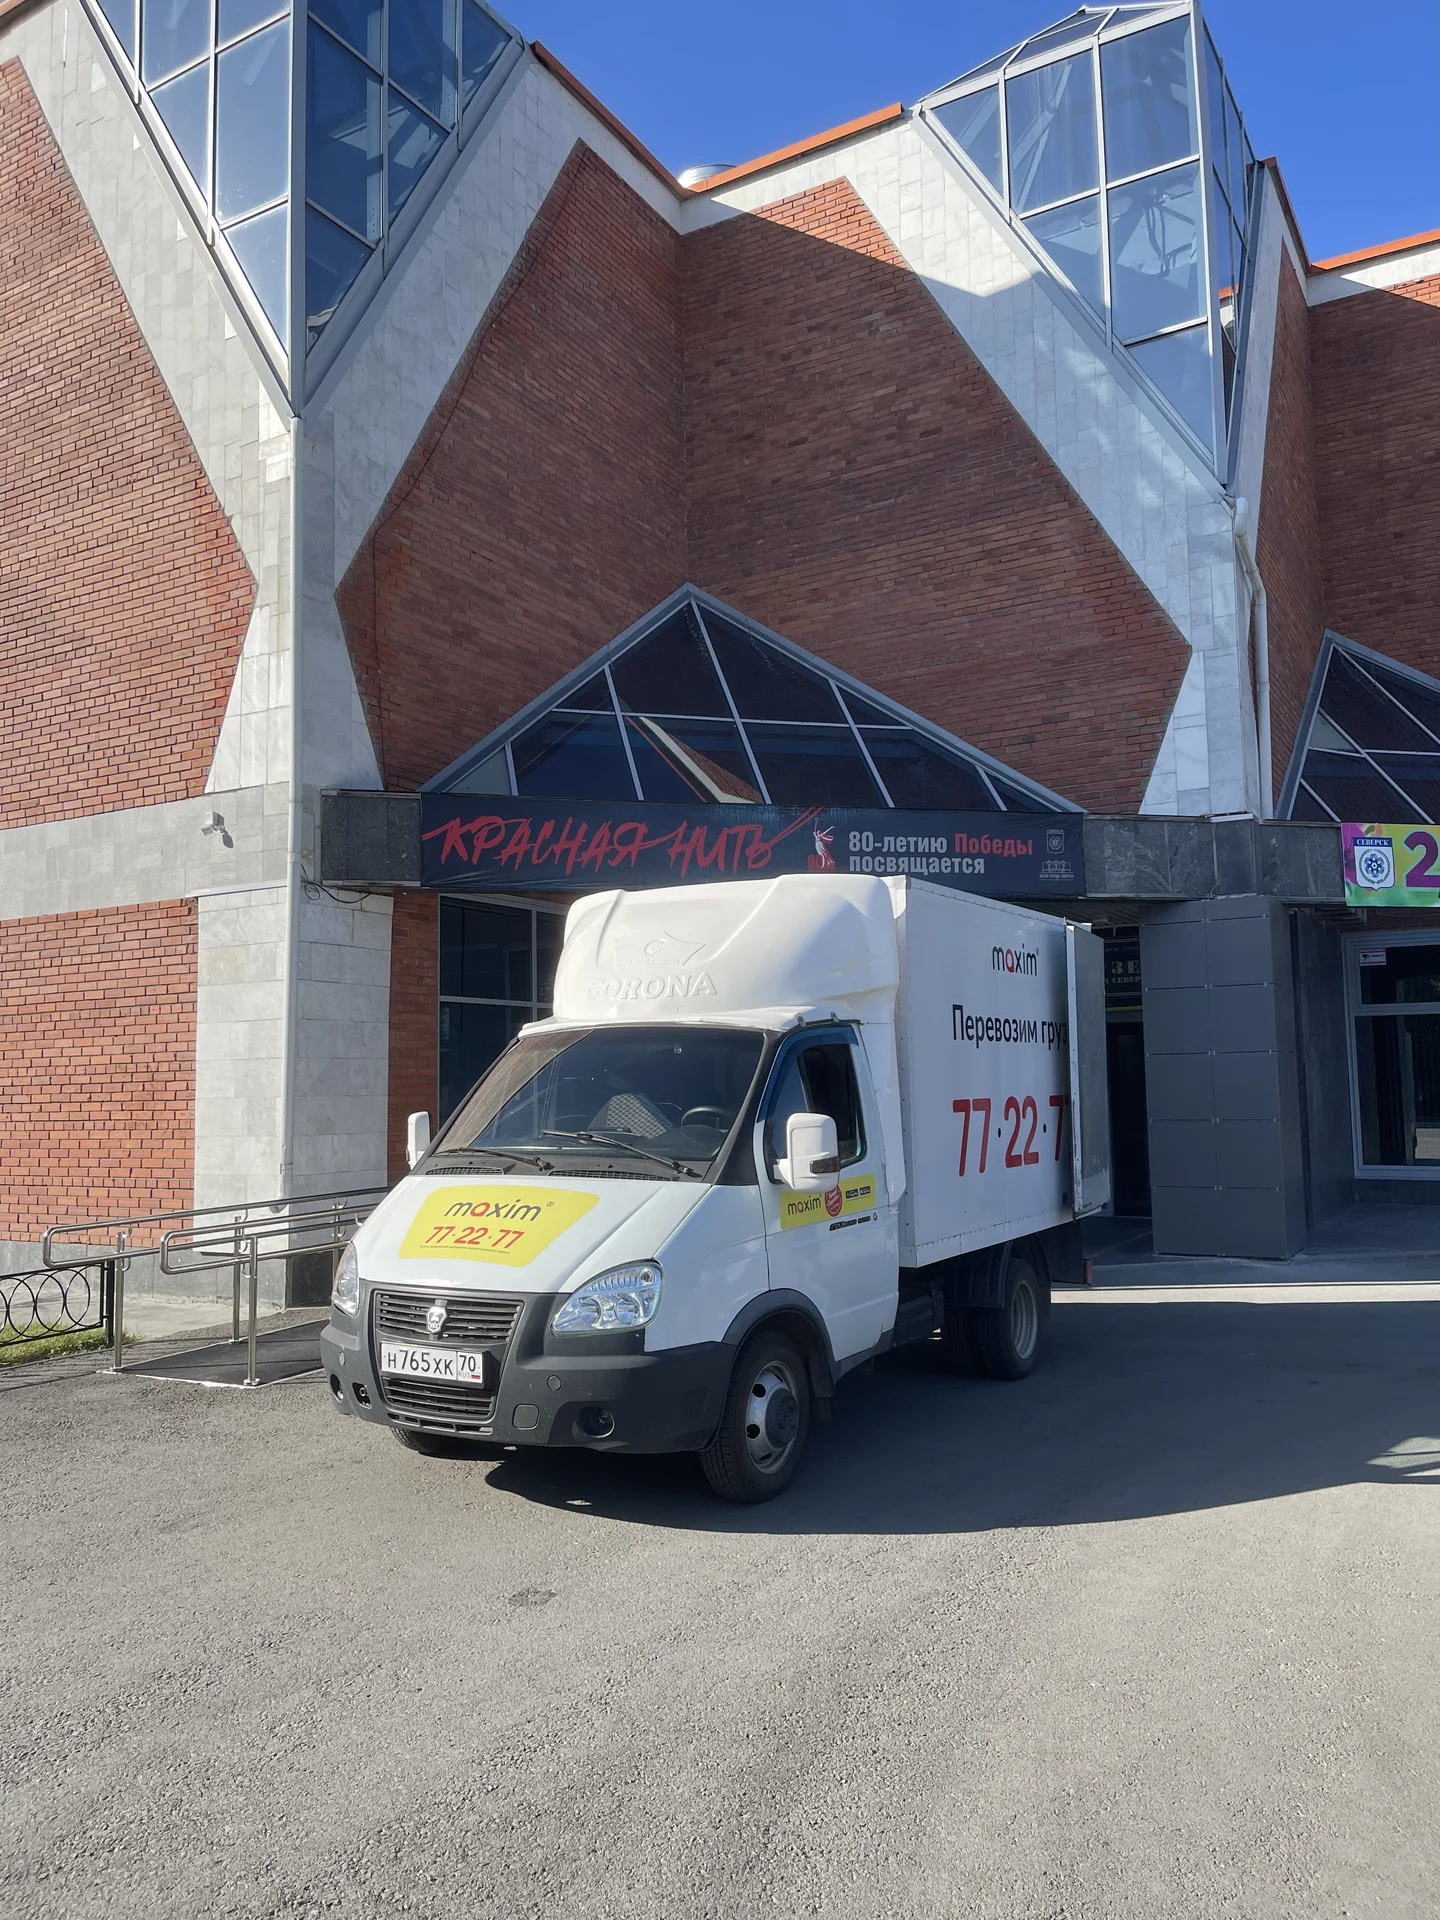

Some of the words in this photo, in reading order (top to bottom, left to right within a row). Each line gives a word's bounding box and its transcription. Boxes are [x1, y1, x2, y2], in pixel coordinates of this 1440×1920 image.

[422, 815, 662, 877] КРАСНАЯ
[668, 817, 780, 879] НИТЬ
[848, 831, 948, 854] 80-летию
[954, 834, 1033, 858] Победы
[1356, 838, 1389, 846] СЕВЕРСК
[849, 855, 985, 876] посвящается
[992, 943, 1038, 976] maxim
[588, 971, 718, 1000] CORONA
[952, 1004, 1038, 1049] Перевозим
[1041, 1019, 1068, 1051] груз
[444, 1199, 542, 1221] maxim
[787, 1194, 822, 1215] maxim
[458, 1354, 477, 1373] 70
[458, 1370, 471, 1379] RUS
